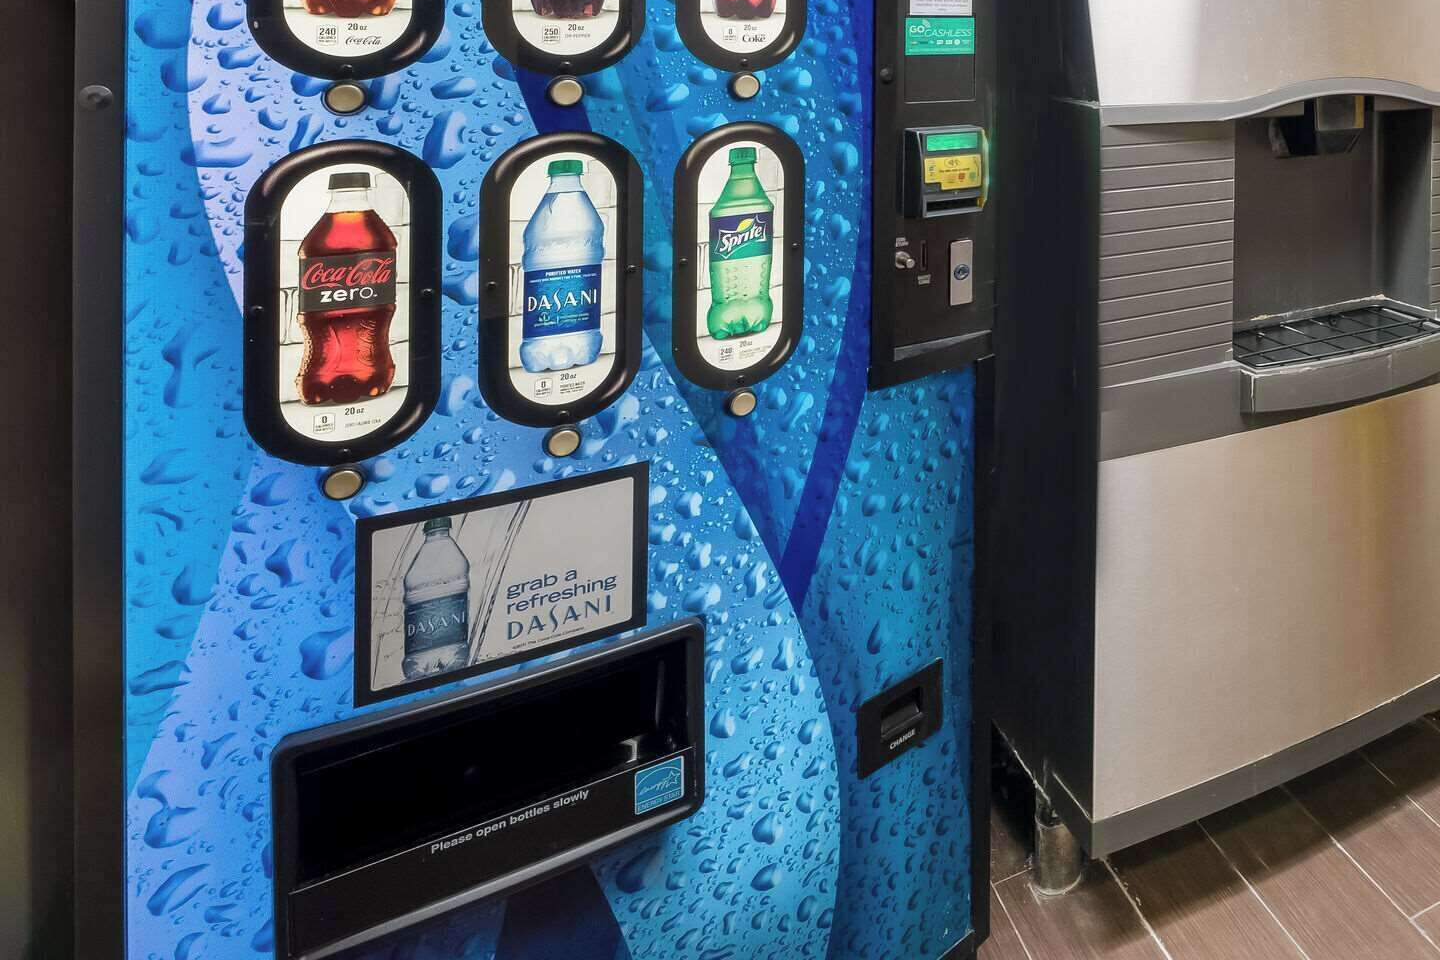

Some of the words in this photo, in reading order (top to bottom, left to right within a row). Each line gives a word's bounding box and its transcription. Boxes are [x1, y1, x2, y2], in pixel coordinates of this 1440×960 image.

[319, 27, 337, 36] 240
[347, 23, 358, 31] 20
[544, 28, 558, 36] 250
[910, 25, 925, 33] GO
[925, 28, 972, 38] CASHLESS
[719, 223, 763, 253] Sprite
[301, 257, 393, 290] Coca-Cola
[320, 286, 374, 303] zero
[527, 288, 597, 312] DASANI
[560, 372, 570, 381] 20
[321, 415, 328, 424] 0
[344, 407, 355, 416] 20
[507, 573, 558, 600] grab
[564, 569, 577, 582] a
[507, 575, 617, 615] refreshing
[407, 611, 465, 637] DASANI
[507, 594, 611, 641] DASANI
[889, 728, 916, 750] CHANGE
[431, 833, 473, 855] Please
[476, 820, 507, 837] open
[510, 803, 550, 825] bottles
[553, 790, 589, 809] slowly
